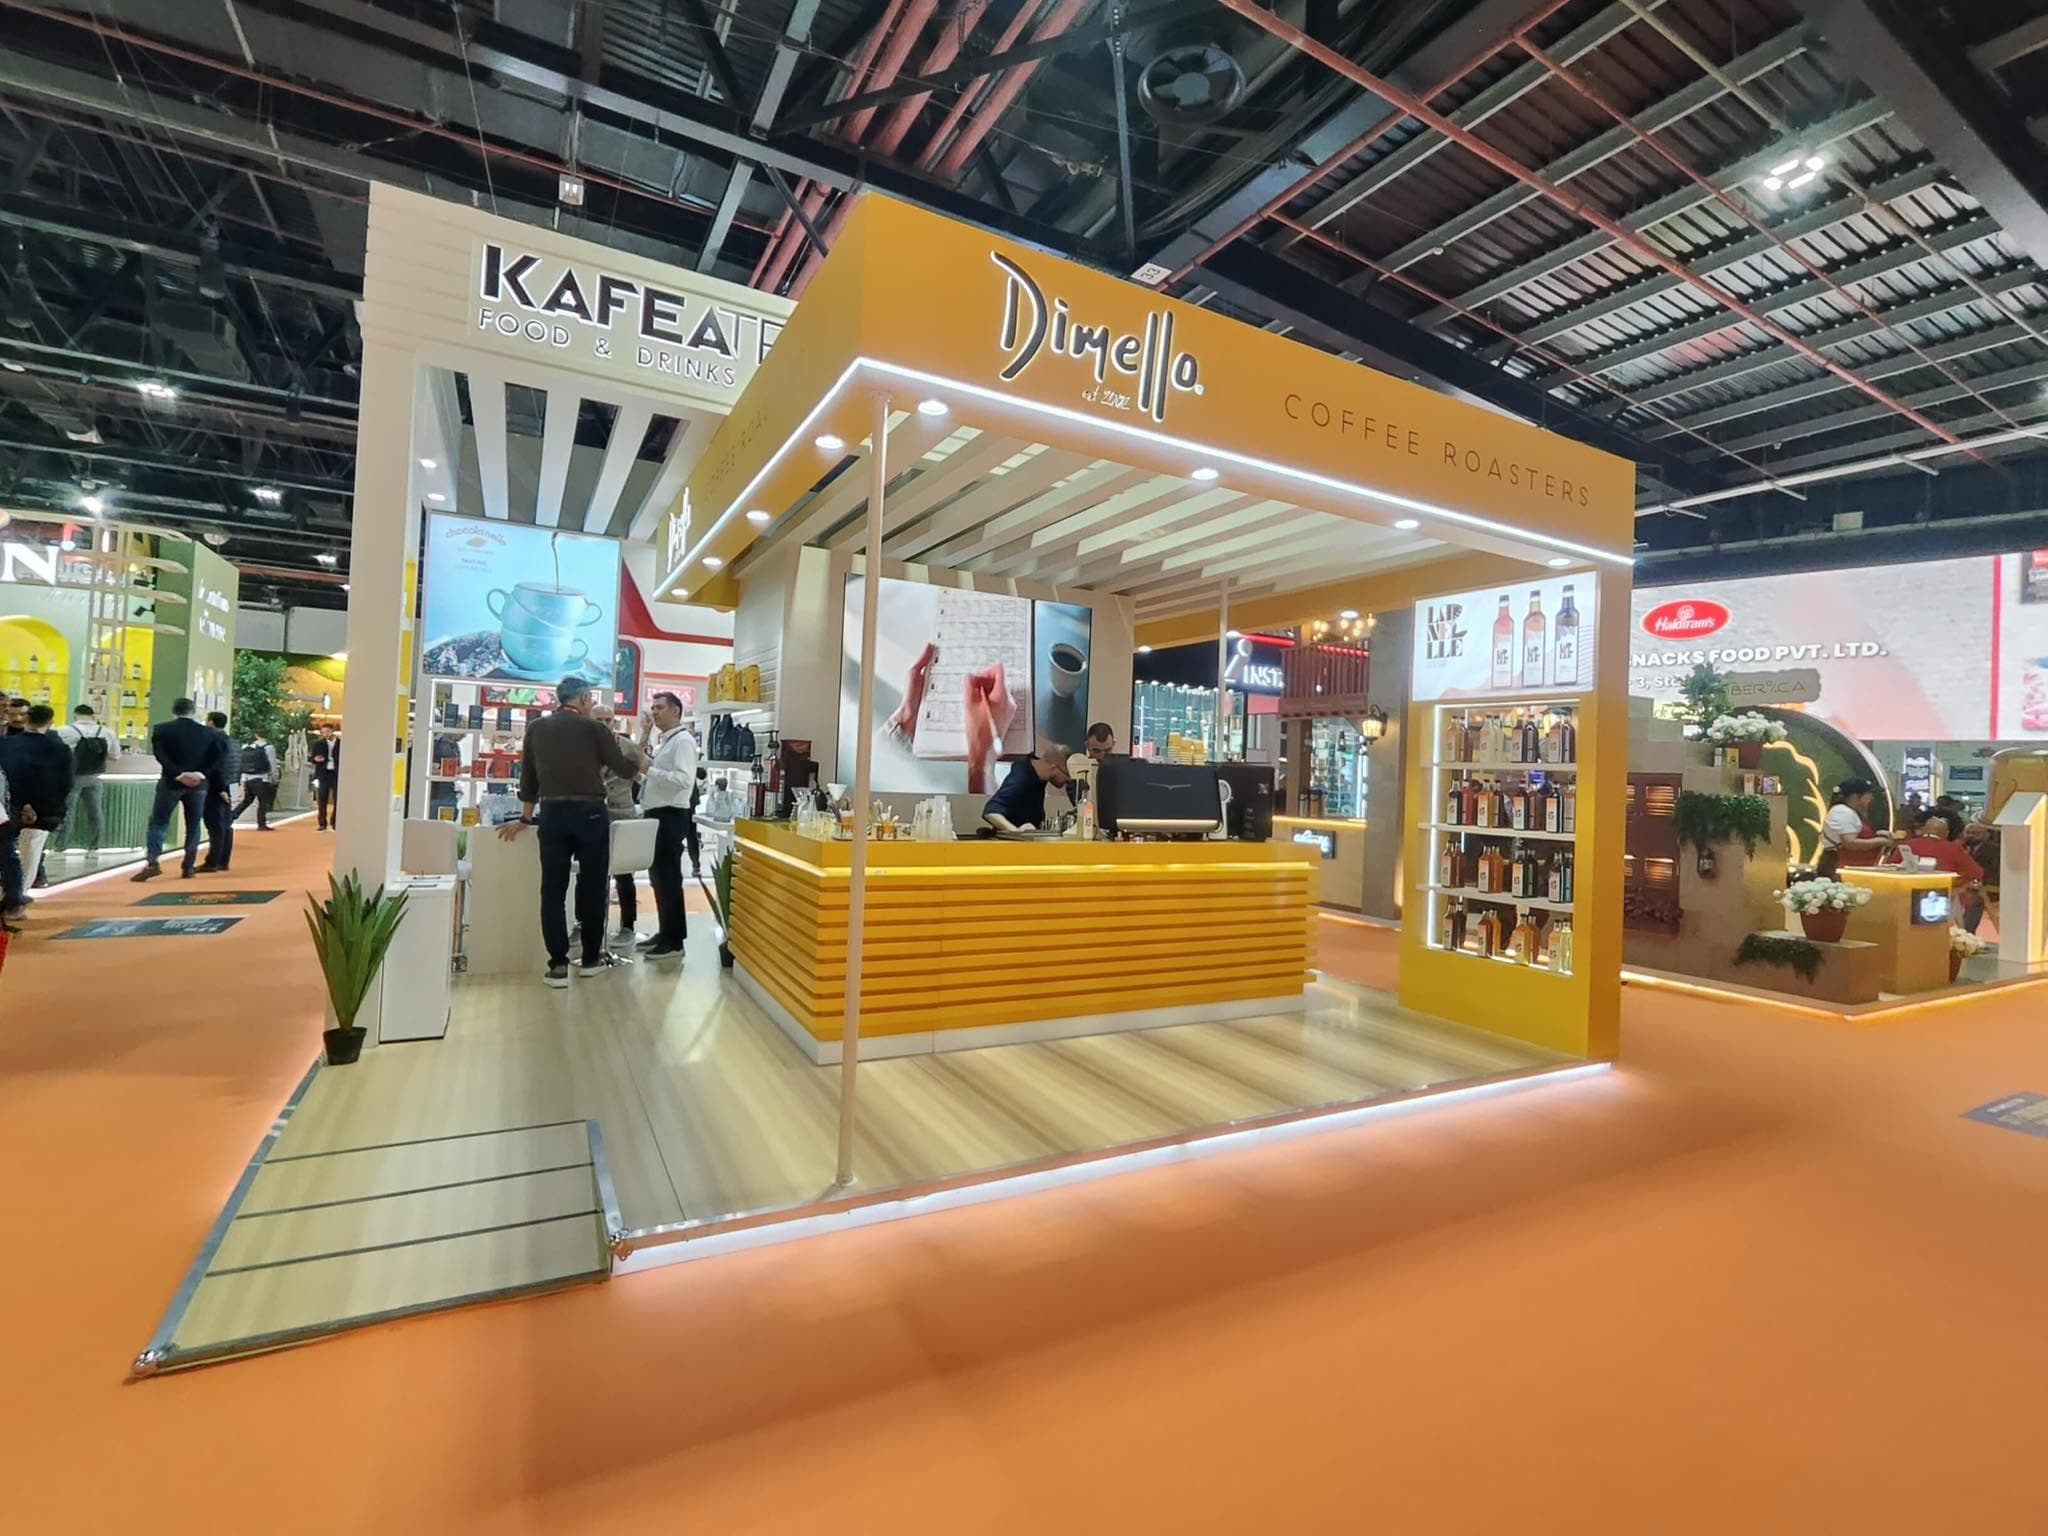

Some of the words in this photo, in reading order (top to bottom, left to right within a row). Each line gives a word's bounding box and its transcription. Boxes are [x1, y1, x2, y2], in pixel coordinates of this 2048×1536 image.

[478, 307, 571, 347] FOOD
[595, 337, 612, 360] &
[637, 346, 736, 389] DRINKS
[1284, 393, 1419, 455] COFFEE
[1444, 441, 1589, 507] ROASTERS
[1655, 616, 1716, 632] Haldiram's
[1628, 651, 1705, 668] NACKS
[1709, 648, 1770, 664] FOOD
[1775, 644, 1829, 661] PVT.
[1834, 641, 1889, 658] LTD.
[1243, 664, 1285, 688] INST
